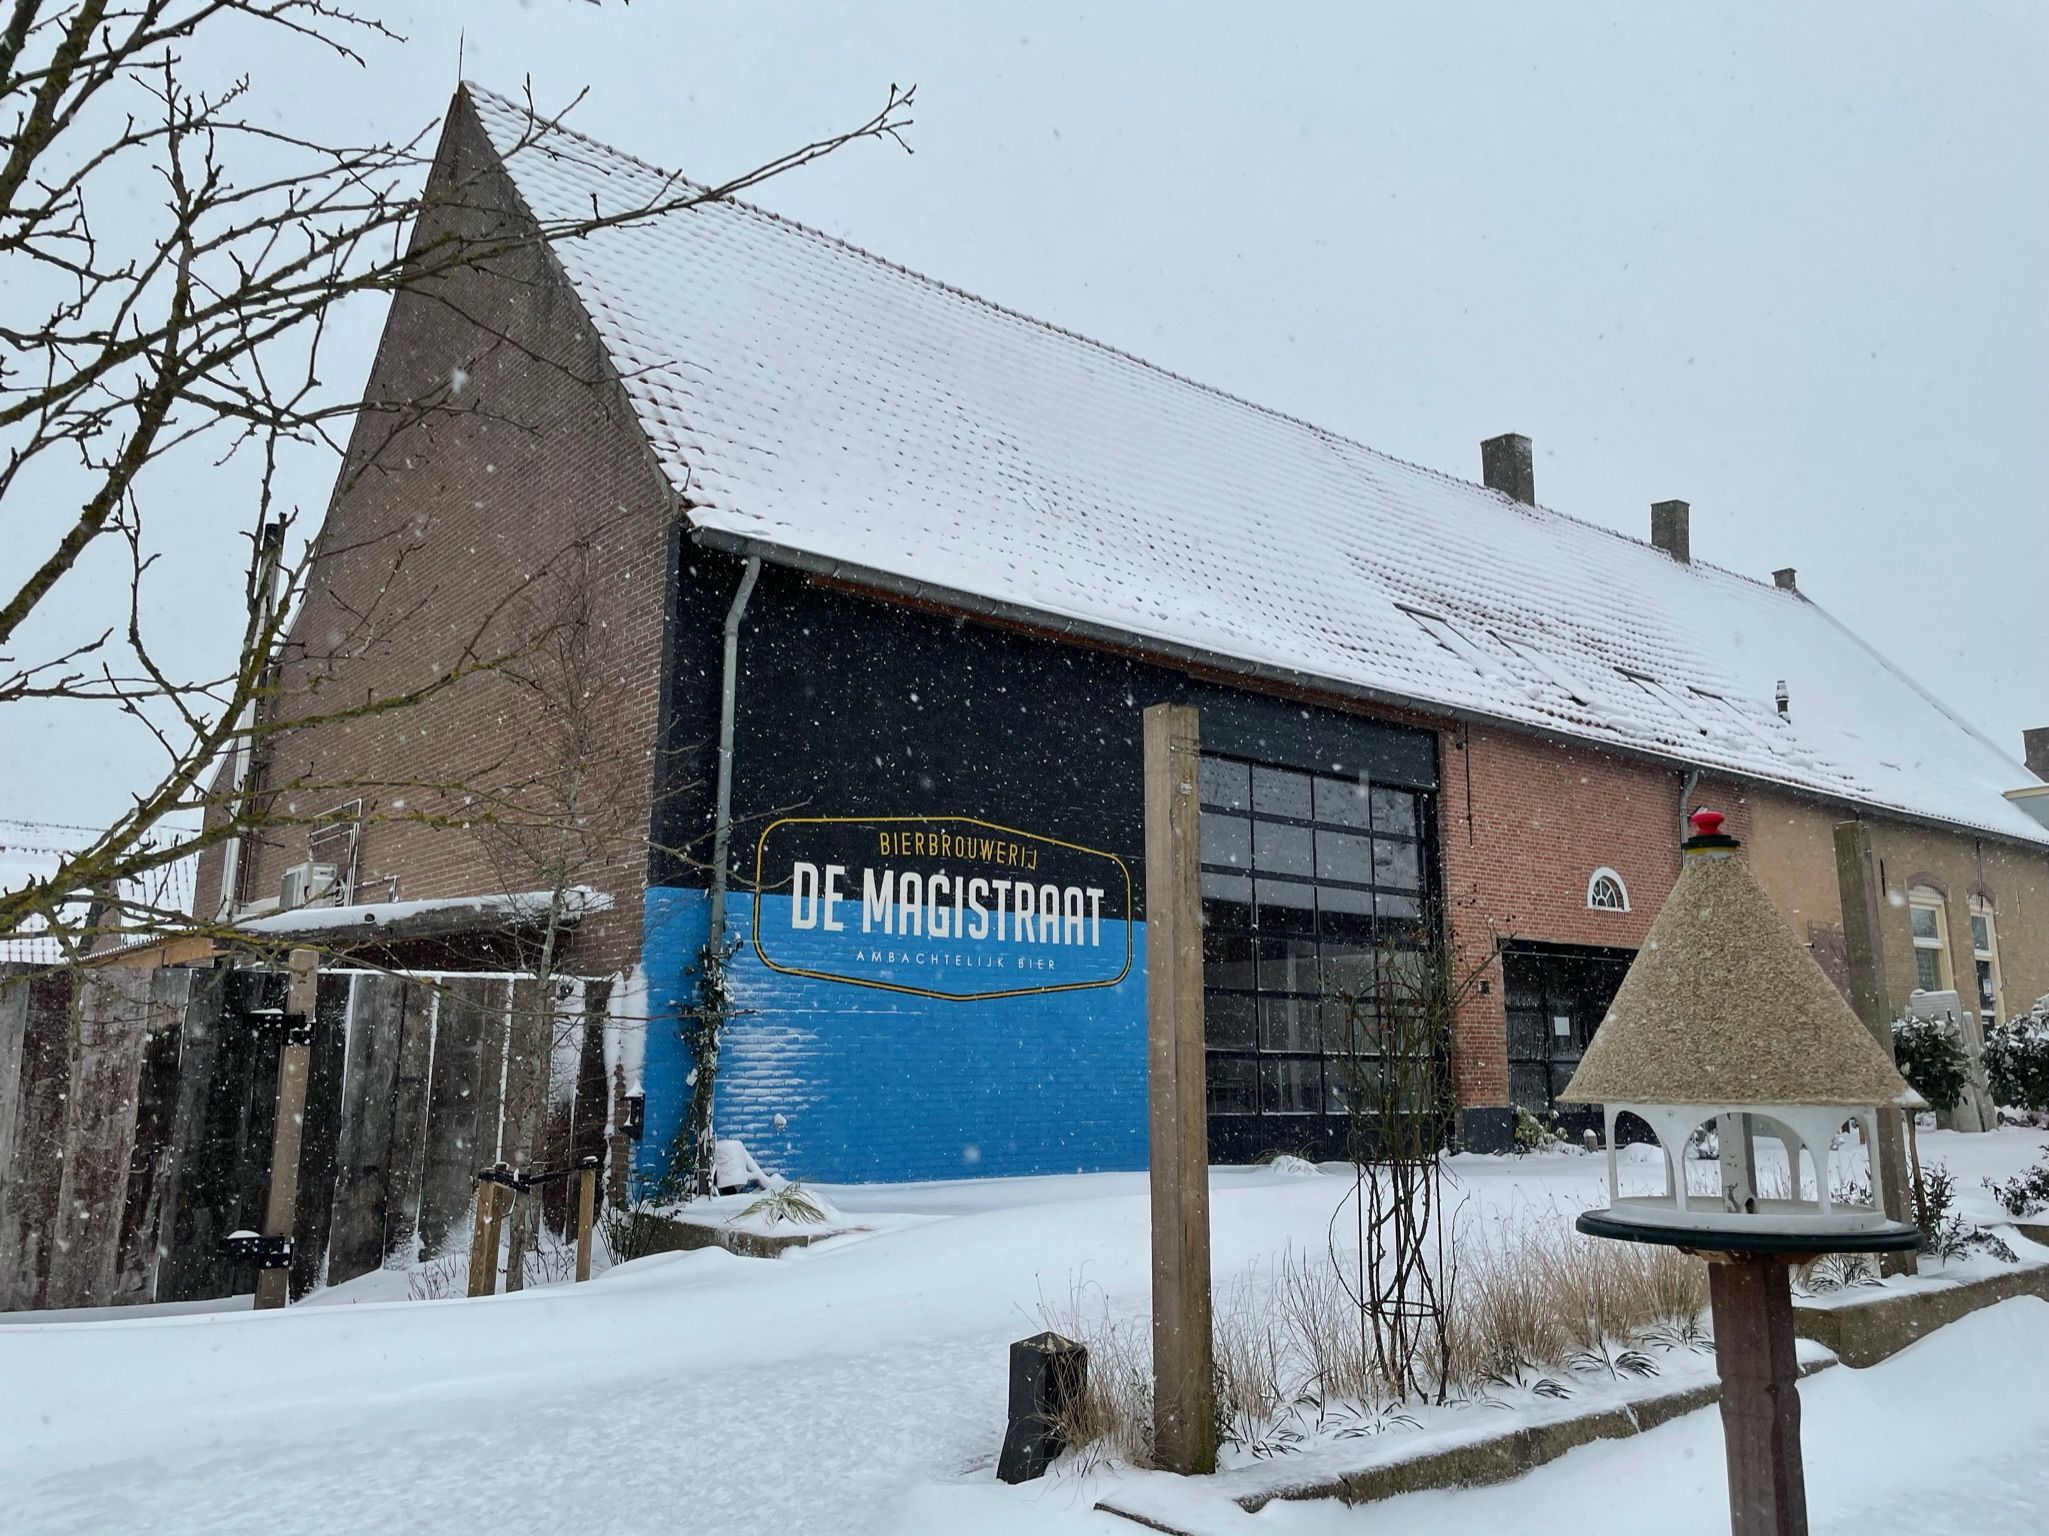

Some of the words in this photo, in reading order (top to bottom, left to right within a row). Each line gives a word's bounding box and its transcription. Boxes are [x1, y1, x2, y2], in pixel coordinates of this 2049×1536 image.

[880, 832, 1038, 871] BIERBROUWERIJ
[792, 862, 845, 932] DE
[862, 867, 1104, 947] MAGISTRAAT
[856, 951, 1005, 968] AMBACHTELIJK
[1018, 958, 1056, 970] BIER
